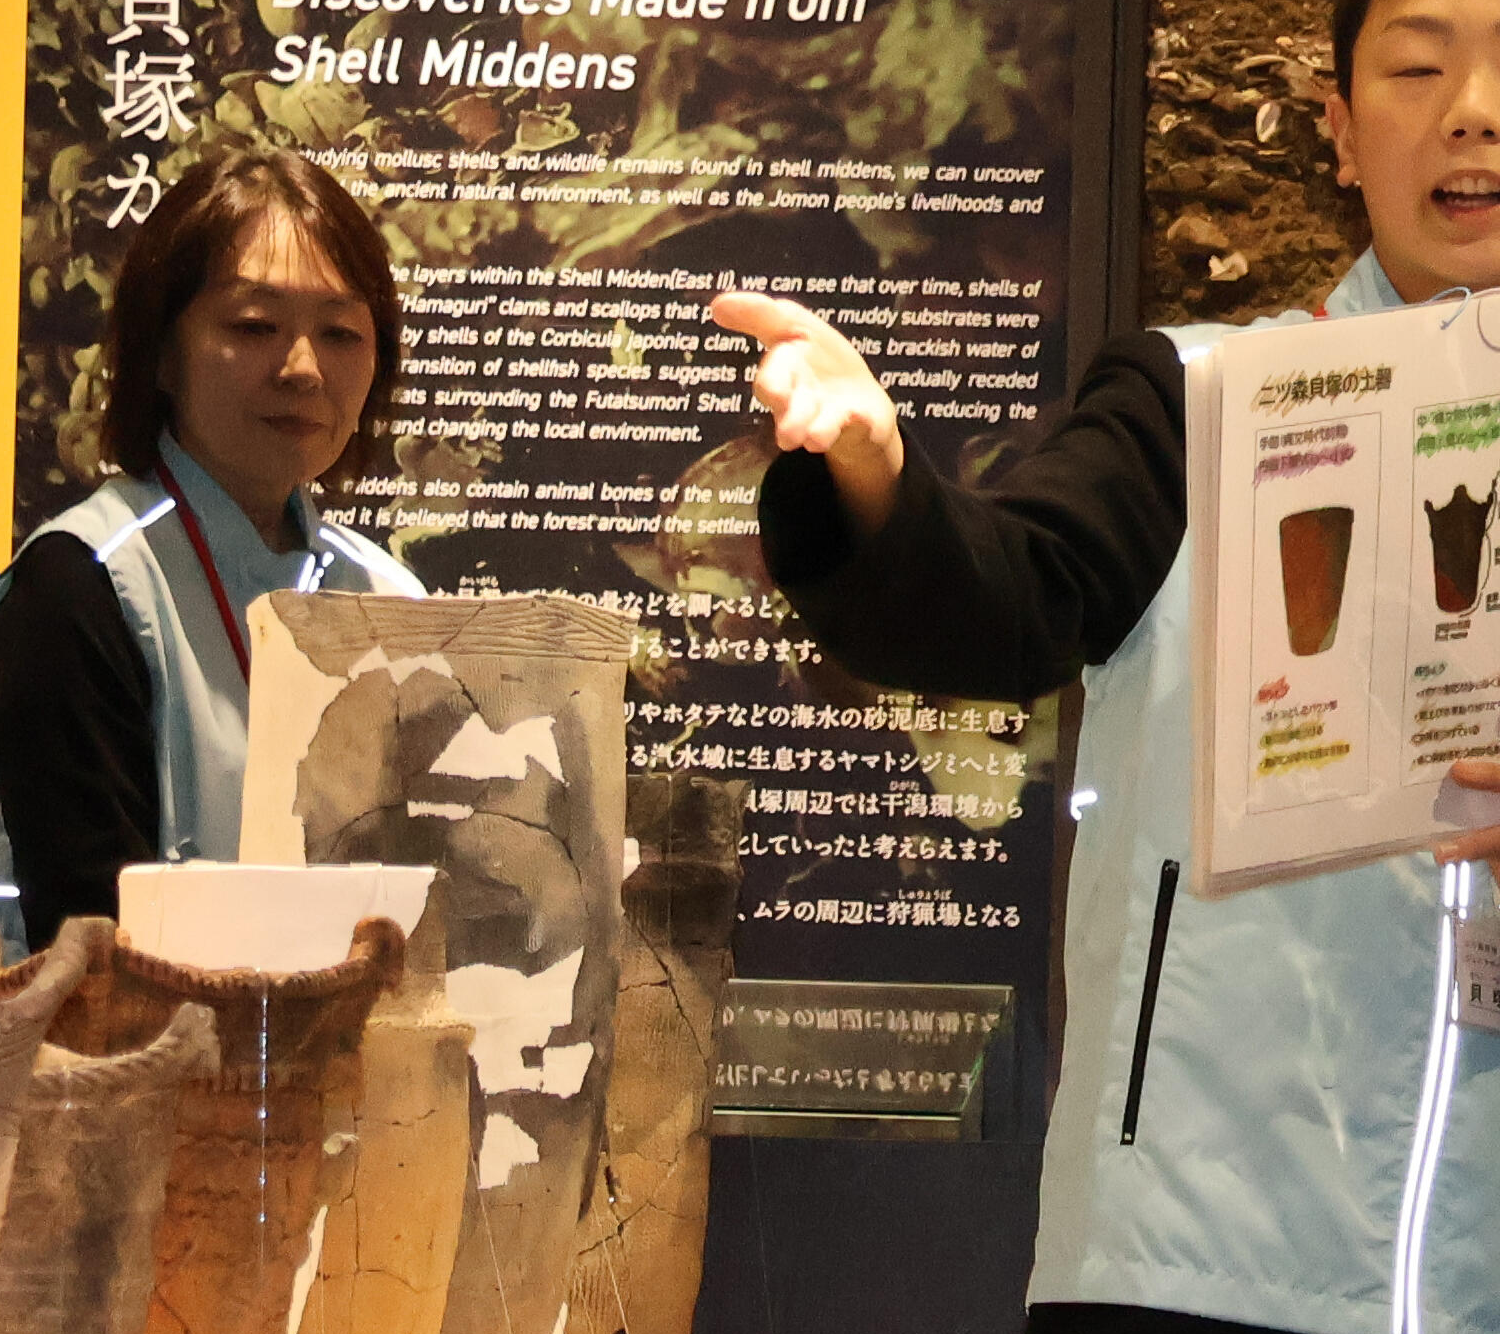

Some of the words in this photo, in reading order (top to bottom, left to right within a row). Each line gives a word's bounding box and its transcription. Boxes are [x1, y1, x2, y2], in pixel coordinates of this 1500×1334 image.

[270, 36, 401, 85] Shell
[419, 38, 637, 90] Middens
[374, 148, 442, 168] mollusc
[448, 150, 500, 170] shells
[504, 151, 540, 171] and
[544, 152, 608, 172] wildlife
[612, 154, 684, 174] remains
[690, 156, 740, 176] found
[746, 157, 764, 176] in
[768, 158, 812, 178] shell
[816, 159, 898, 183] middens,
[902, 165, 930, 181] we
[934, 166, 968, 181] can
[972, 167, 1044, 183] uncover
[350, 179, 378, 198] the
[382, 180, 448, 200] ancient
[452, 181, 514, 201] natural
[520, 183, 634, 207] environment,
[638, 189, 662, 204] as
[666, 186, 704, 205] well
[708, 191, 730, 206] as
[736, 188, 764, 207] the
[768, 188, 830, 208] Jomon
[834, 190, 906, 215] people's
[912, 191, 1004, 212] livelihoods
[1008, 194, 1044, 213] and
[412, 264, 468, 289] layers
[470, 265, 524, 285] within
[526, 267, 554, 286] the
[558, 267, 602, 287] Shell
[606, 268, 714, 292] Midden(East
[716, 271, 738, 293] II),
[742, 275, 768, 291] we
[770, 276, 802, 291] can
[806, 276, 838, 292] see
[840, 274, 876, 293] that
[878, 278, 920, 294] over
[922, 276, 964, 298] time,
[968, 277, 1018, 296] shells
[1022, 278, 1042, 297] of
[396, 294, 498, 320] "Hamaguri"
[498, 296, 550, 316] clams
[552, 298, 590, 317] and
[590, 299, 660, 324] scallops
[664, 300, 700, 320] that
[838, 305, 898, 330] muddy
[900, 306, 992, 327] substrates
[996, 312, 1040, 328] were
[400, 324, 422, 348] by
[426, 325, 478, 345] shells
[482, 326, 502, 345] of
[506, 327, 536, 346] the
[540, 327, 622, 348] Corbicula
[624, 329, 700, 355] japonica
[704, 331, 750, 354] clam,
[886, 336, 960, 356] brackish
[966, 337, 1016, 357] water
[1020, 339, 1040, 358] of
[400, 355, 476, 375] ransition
[482, 357, 502, 376] of
[508, 358, 580, 378] shellfish
[586, 360, 652, 385] species
[658, 361, 736, 387] suggests
[880, 367, 962, 392] gradually
[968, 369, 1040, 389] receded
[434, 387, 542, 413] surrounding
[548, 389, 578, 409] the
[584, 390, 690, 411] Futatsumori
[696, 393, 742, 413] Shell
[924, 399, 1002, 424] reducing
[1008, 401, 1038, 420] the
[392, 416, 426, 435] and
[428, 417, 508, 442] changing
[512, 419, 540, 438] the
[544, 419, 586, 439] local
[588, 421, 702, 442] environment.
[422, 478, 460, 497] also
[466, 479, 530, 499] contain
[534, 481, 594, 501] animal
[600, 482, 654, 502] bones
[658, 484, 680, 503] of
[684, 485, 714, 504] the
[718, 486, 756, 505] wild
[322, 505, 356, 524] and
[358, 506, 372, 525] it
[376, 506, 392, 525] is
[396, 507, 468, 527] believed
[472, 509, 508, 528] that
[510, 510, 540, 529] the
[542, 511, 596, 531] forest
[596, 512, 662, 533] around
[664, 514, 694, 534] the
[626, 742, 1028, 778] る汽水域に生息するヤマトシジミへと変
